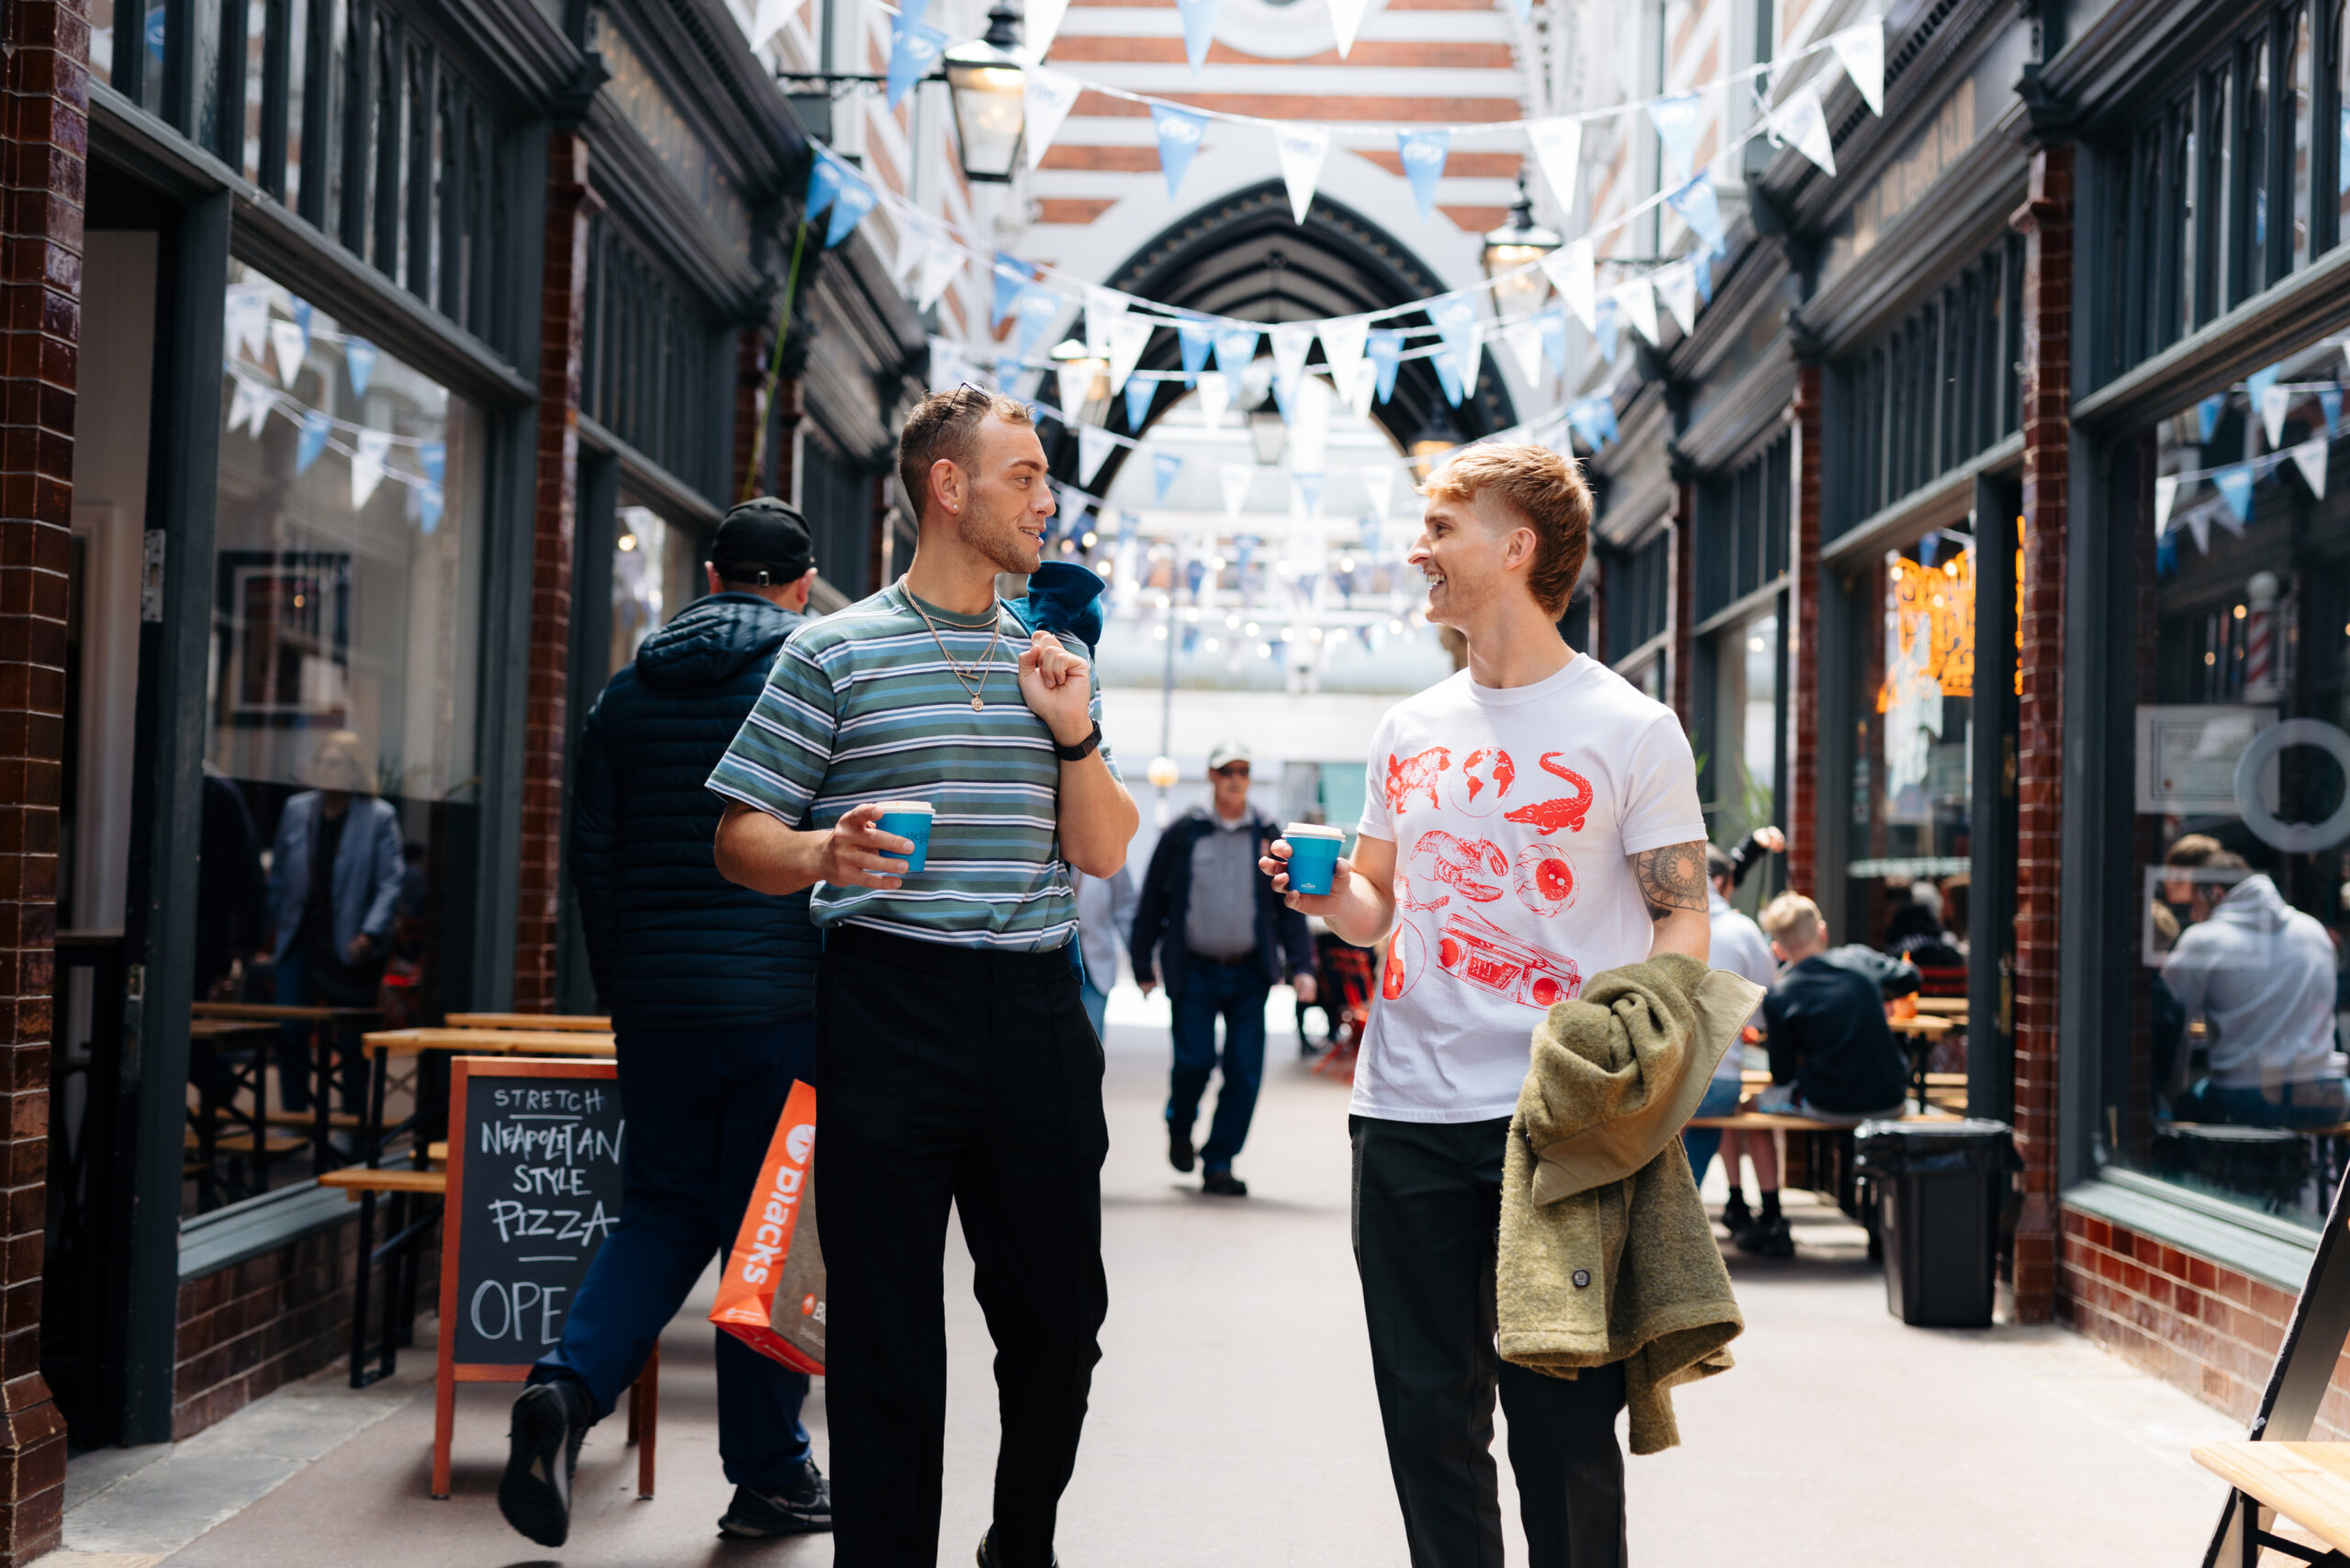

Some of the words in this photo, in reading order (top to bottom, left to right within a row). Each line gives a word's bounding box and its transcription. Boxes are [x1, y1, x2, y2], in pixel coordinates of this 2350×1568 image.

[494, 1088, 605, 1114] STRETCH
[482, 1119, 625, 1166] NEAPOLITAN
[512, 1164, 592, 1196] STYLE
[487, 1199, 621, 1248] PIZZA
[470, 1280, 567, 1346] OPE
